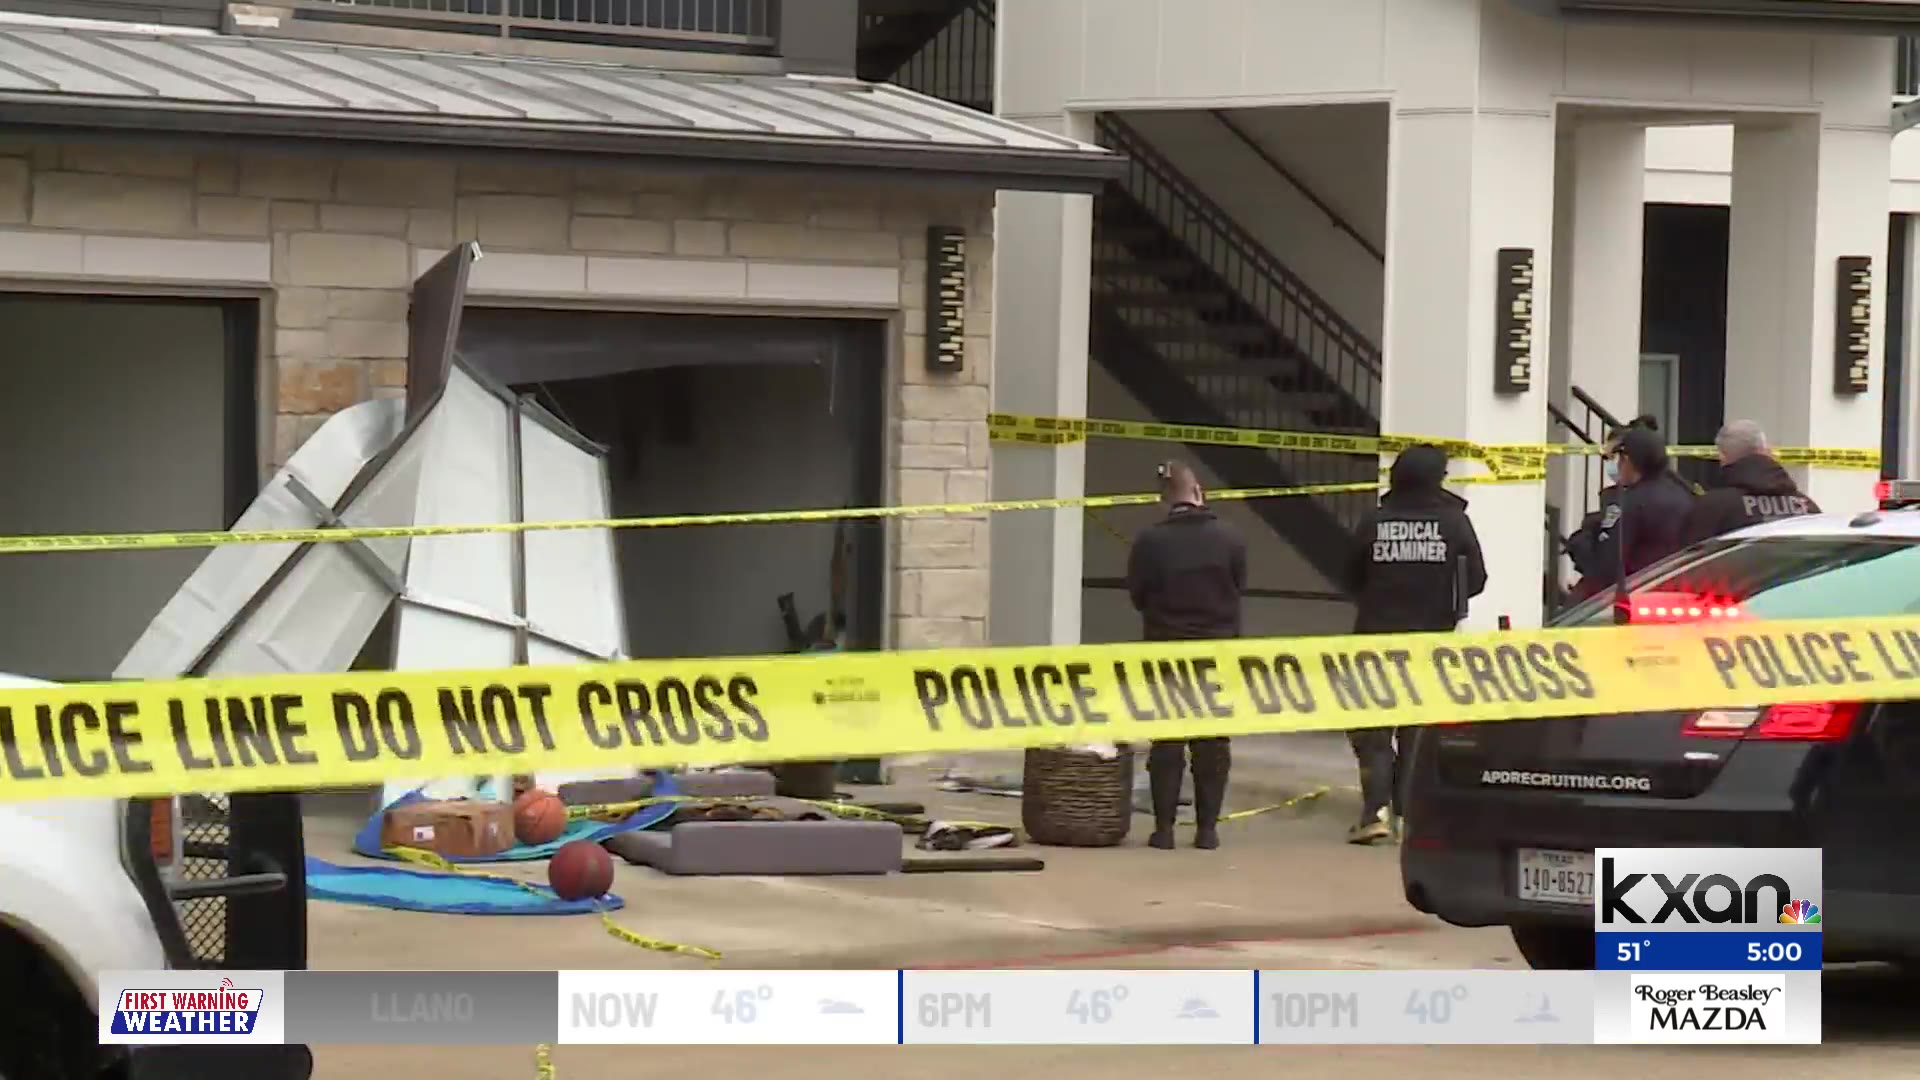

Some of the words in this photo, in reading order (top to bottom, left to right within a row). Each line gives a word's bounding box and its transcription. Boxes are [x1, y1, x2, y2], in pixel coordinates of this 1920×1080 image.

[1742, 495, 1808, 516] POLICE
[1377, 521, 1442, 540] MEDICAL
[1372, 541, 1447, 562] EXAMINER
[1702, 630, 1874, 689] POLICE
[912, 661, 1110, 732] POLICE
[1113, 656, 1234, 722] LINE
[1237, 652, 1317, 714] DO
[1320, 648, 1423, 711] NOT
[1430, 641, 1595, 705] CROSS
[168, 694, 318, 770] LINE
[332, 687, 422, 761] DO
[437, 683, 556, 755] NOT
[577, 672, 769, 750] CROSS
[1481, 770, 1651, 791] APDRECRUITING.ORG
[1524, 867, 1594, 894] 140-8527
